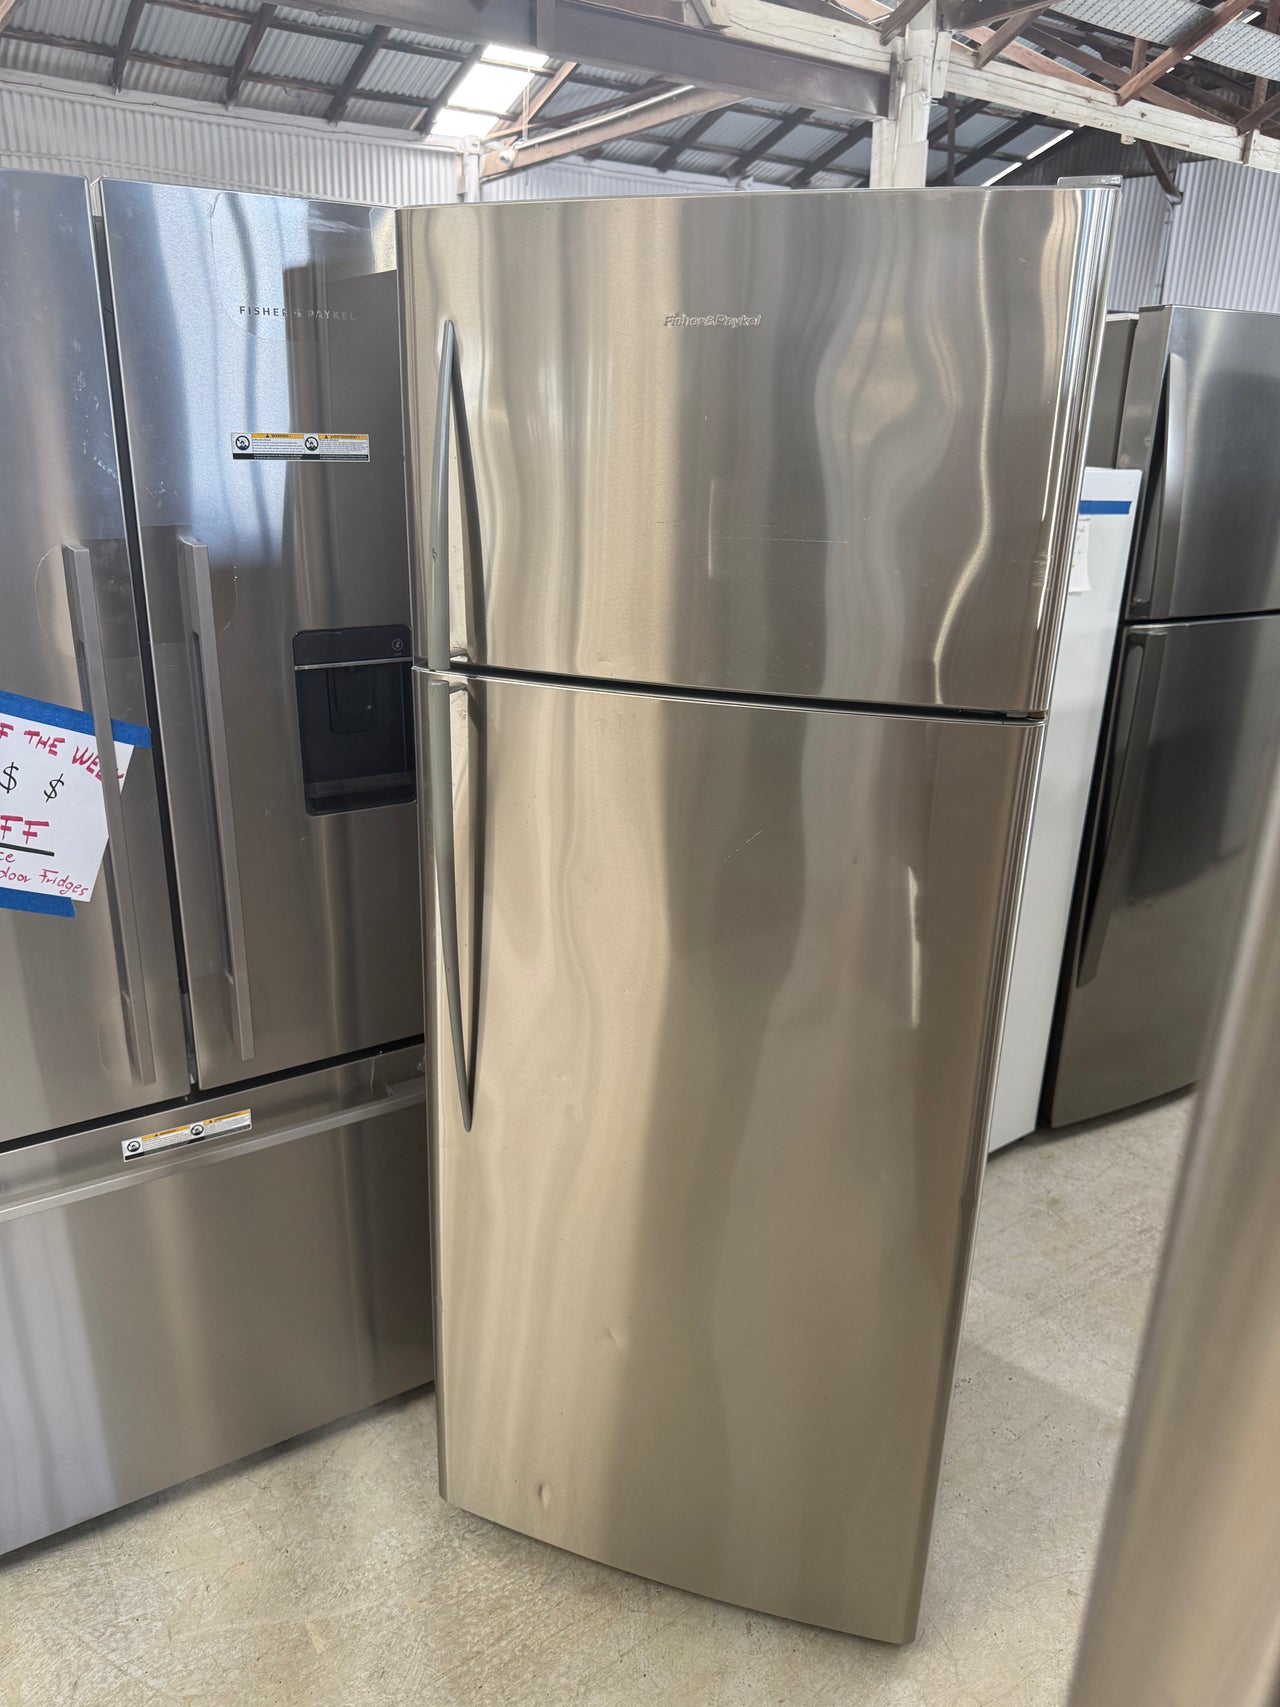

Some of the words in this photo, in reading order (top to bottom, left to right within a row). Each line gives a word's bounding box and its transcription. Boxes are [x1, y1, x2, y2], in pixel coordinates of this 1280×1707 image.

[239, 306, 289, 317] FISHER
[308, 309, 357, 321] PAYKEL
[23, 730, 65, 757] THE
[0, 762, 19, 794] $
[44, 773, 65, 803] $
[39, 868, 89, 896] Fridges
